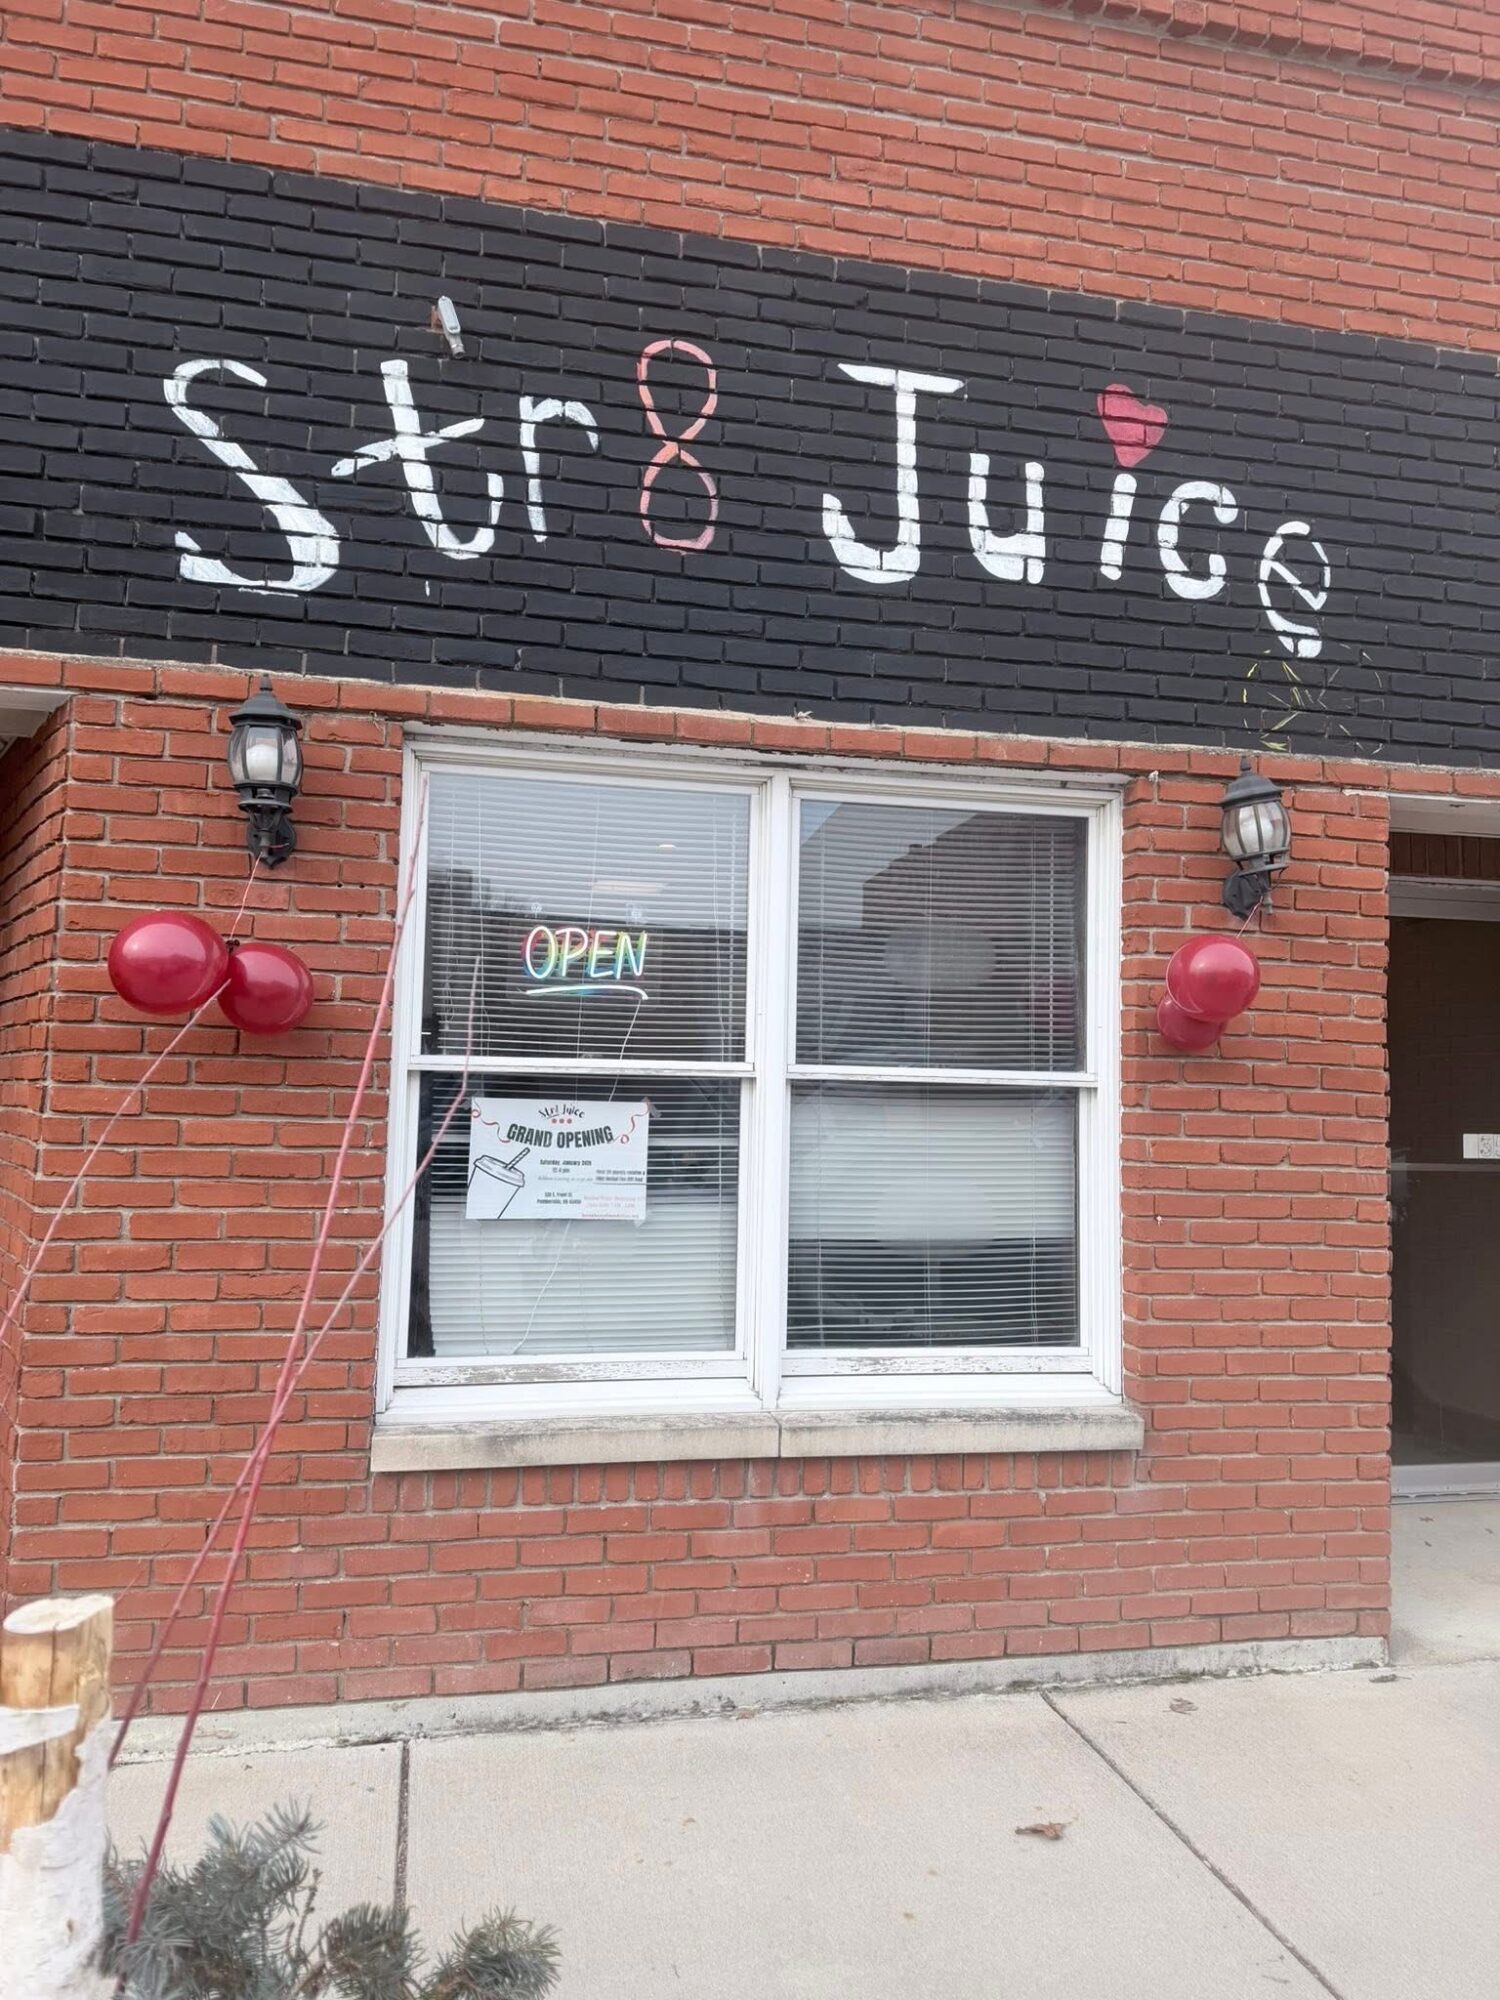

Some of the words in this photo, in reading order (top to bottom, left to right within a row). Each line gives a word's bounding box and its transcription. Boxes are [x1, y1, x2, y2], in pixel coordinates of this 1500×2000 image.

[163, 338, 719, 594] Str8
[822, 362, 1332, 660] Juice
[522, 925, 648, 980] OPEN
[506, 1123, 553, 1148] GRAND
[556, 1125, 614, 1149] OPENING
